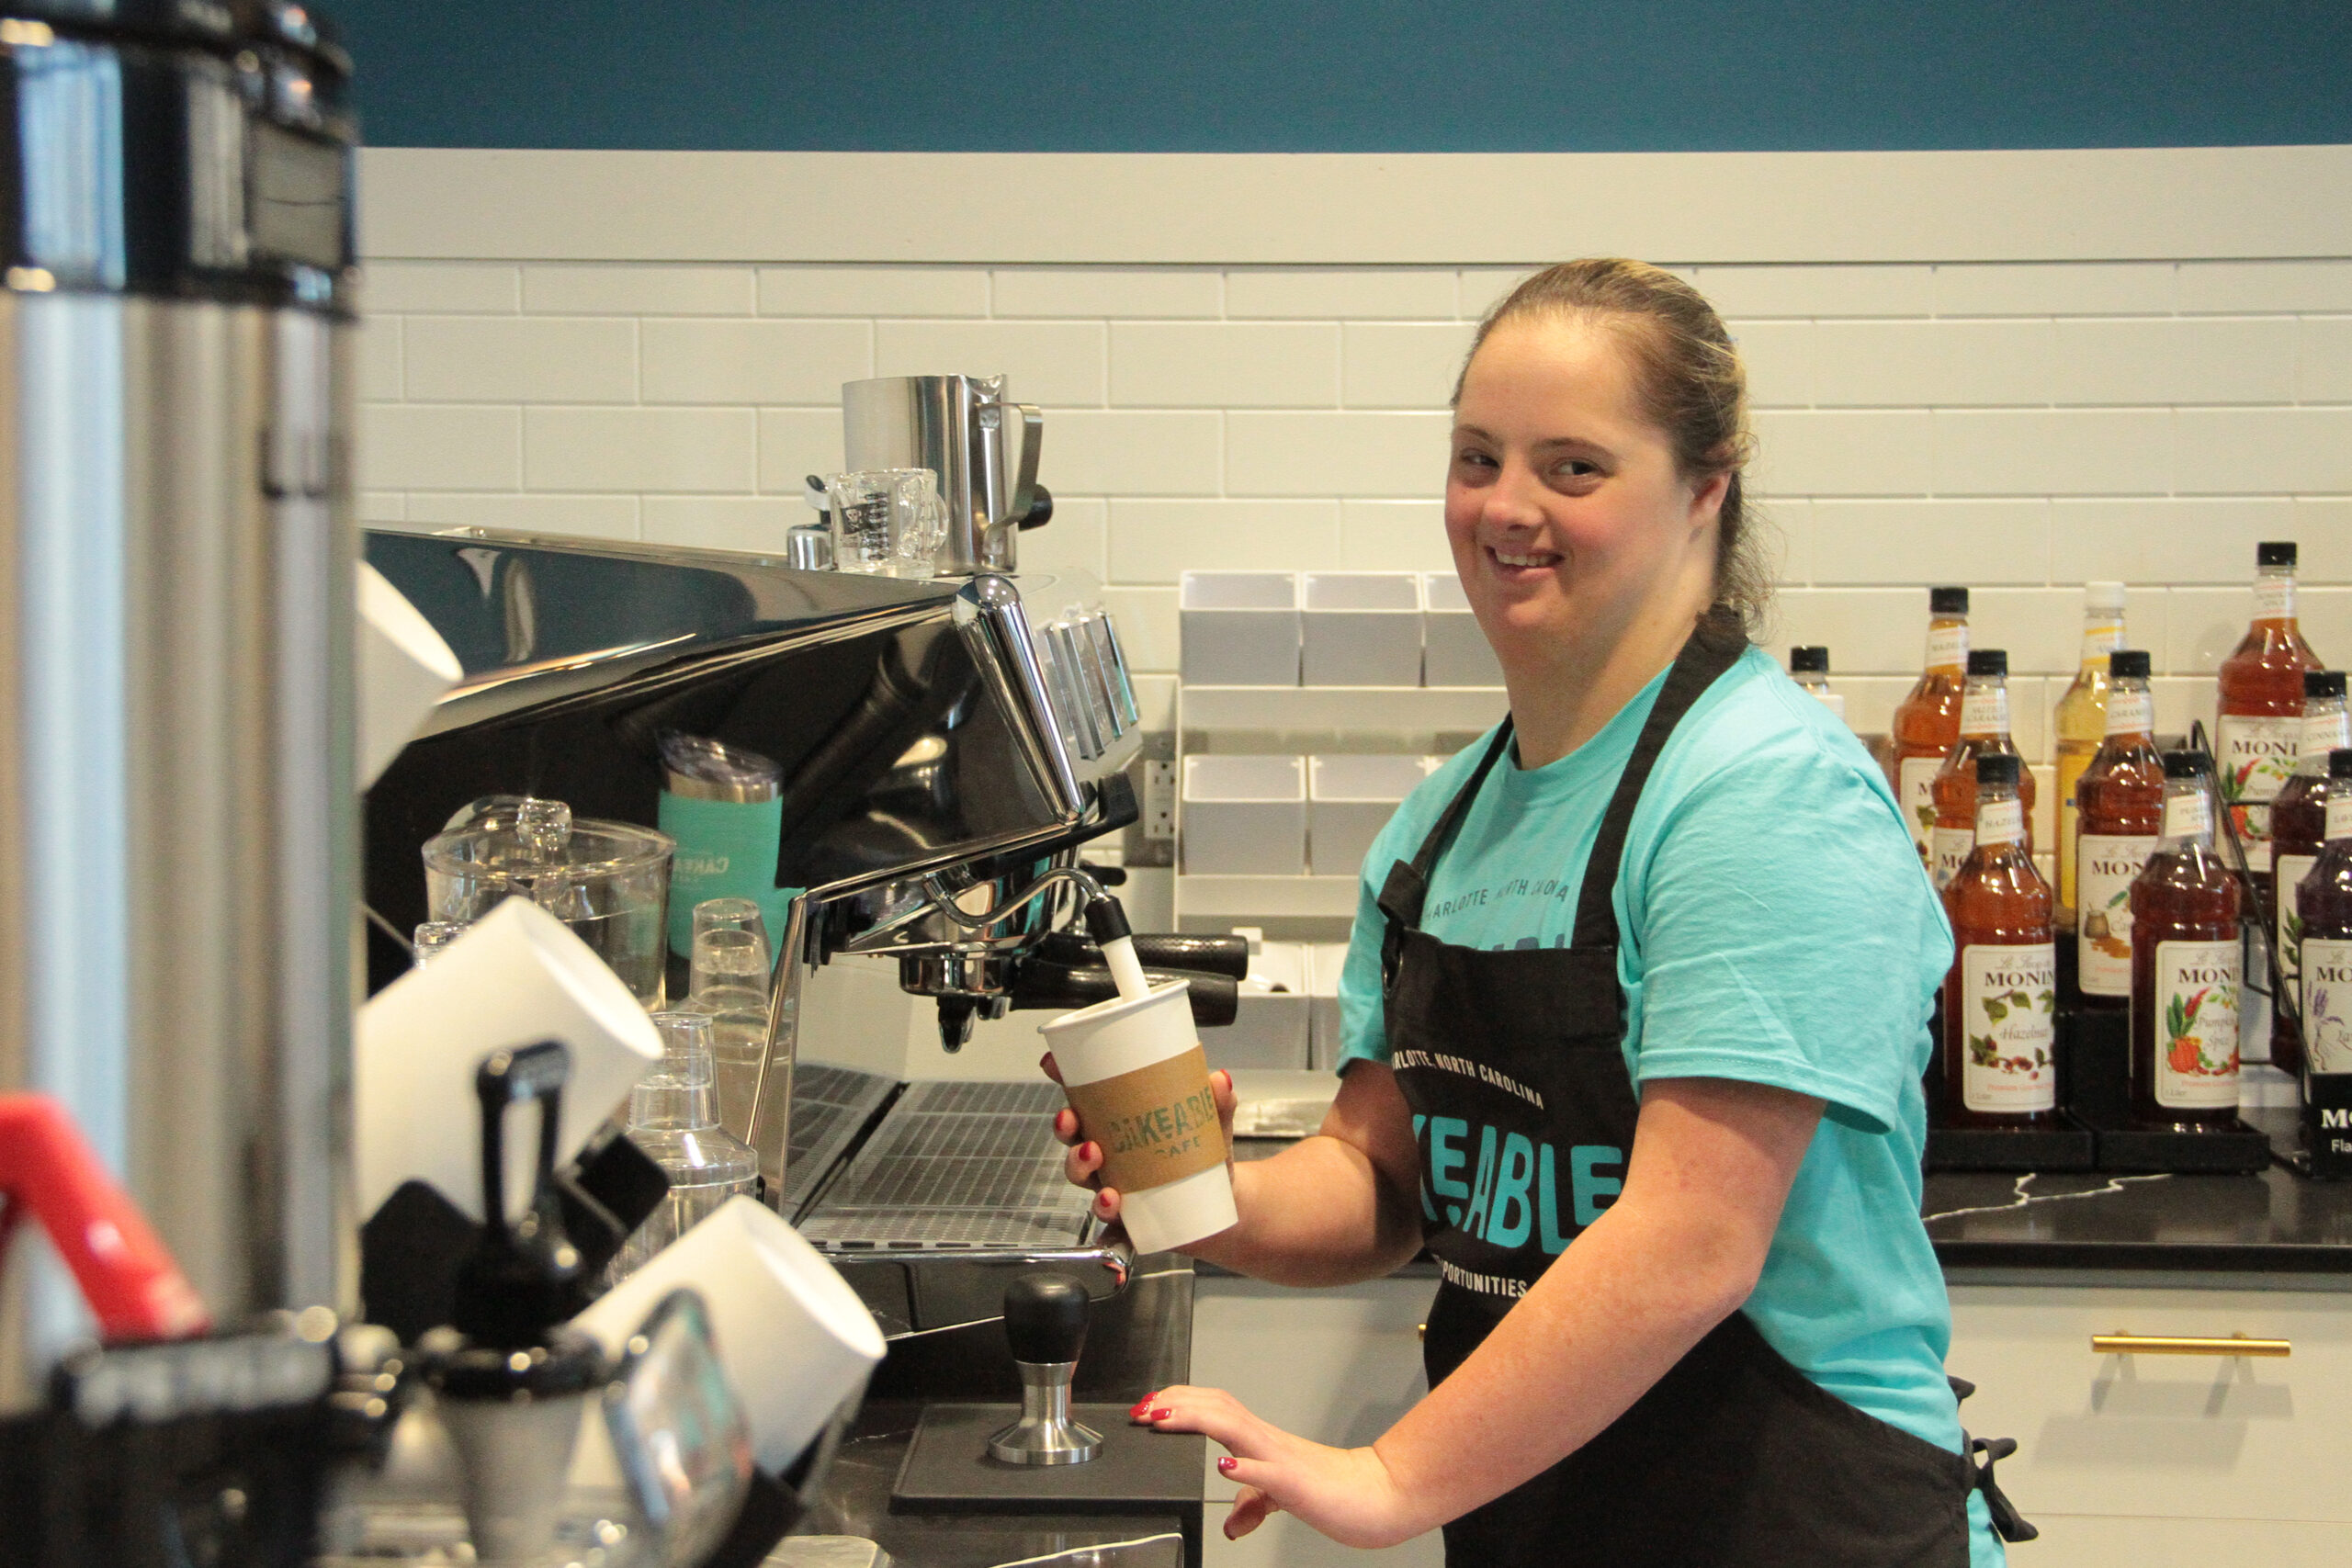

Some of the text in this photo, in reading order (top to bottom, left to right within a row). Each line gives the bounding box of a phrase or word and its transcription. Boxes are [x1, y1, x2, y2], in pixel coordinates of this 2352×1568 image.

[1392, 1049, 1544, 1111] RLOTTE, NORTH CAROLINA
